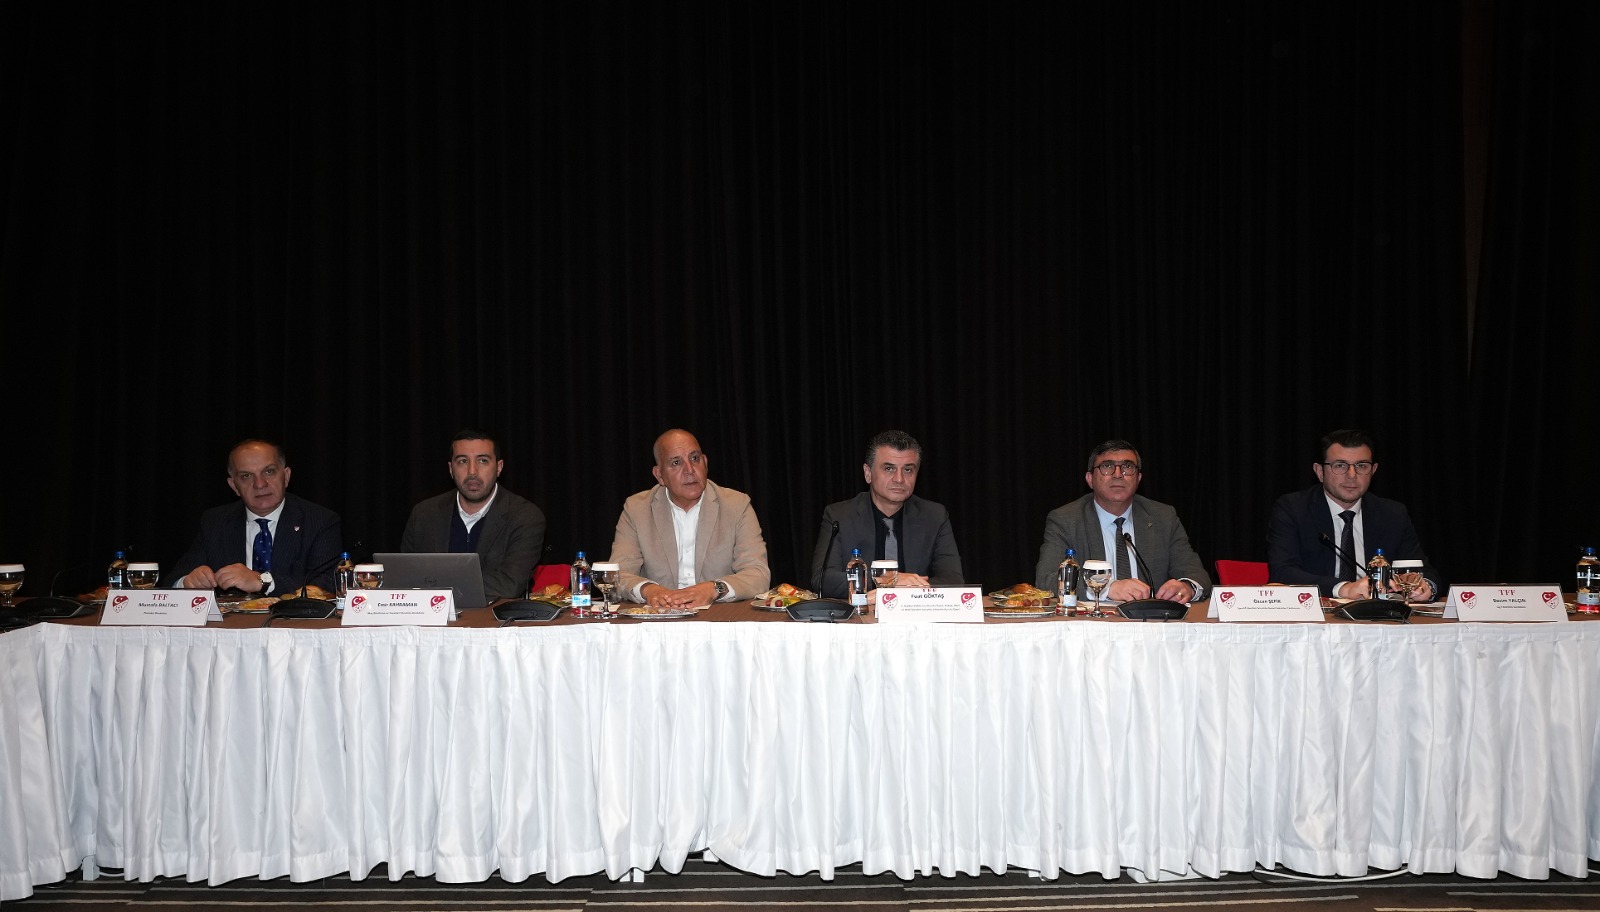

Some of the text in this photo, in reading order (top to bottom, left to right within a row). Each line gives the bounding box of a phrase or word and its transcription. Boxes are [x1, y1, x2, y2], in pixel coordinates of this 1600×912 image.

[152, 593, 169, 601] TFF
[923, 592, 945, 600] GÖKTAŞ
[1257, 589, 1275, 597] TFF
